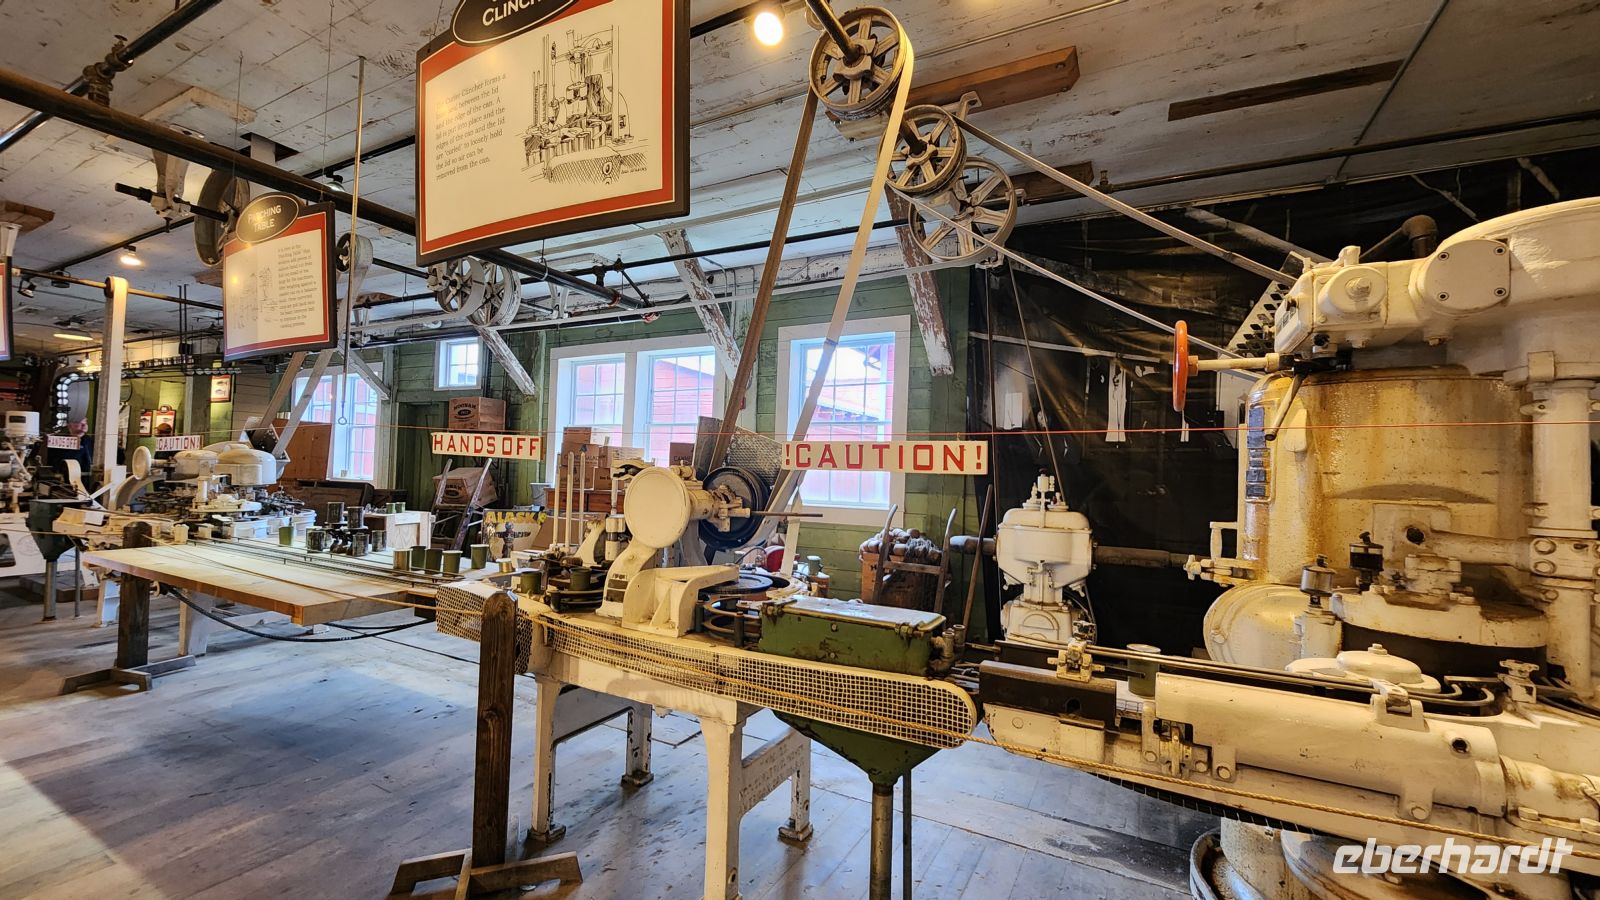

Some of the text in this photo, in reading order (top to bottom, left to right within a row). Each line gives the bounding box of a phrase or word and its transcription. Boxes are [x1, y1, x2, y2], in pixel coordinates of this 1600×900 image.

[433, 434, 540, 457] HANDS OFF
[785, 443, 982, 472] !CAUTION!
